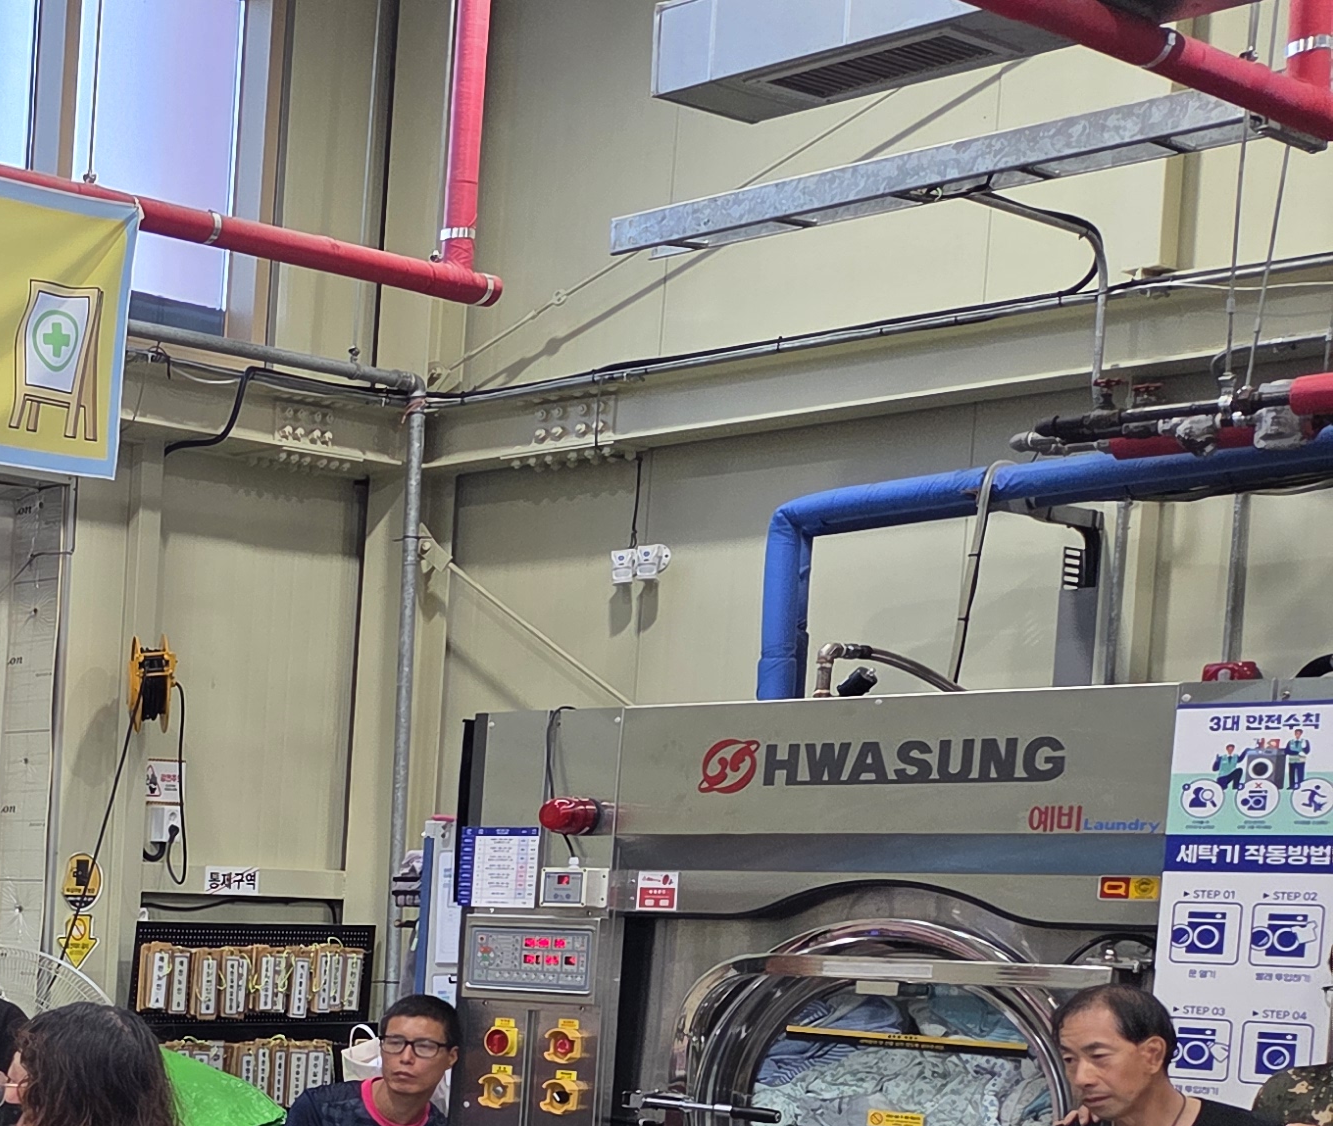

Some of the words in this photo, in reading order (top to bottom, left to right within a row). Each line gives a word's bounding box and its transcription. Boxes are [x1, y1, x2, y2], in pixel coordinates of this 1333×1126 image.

[1209, 715, 1240, 731] 3대
[1246, 713, 1321, 730] 안전수칙
[762, 736, 1066, 786] HWASUNG
[1028, 805, 1083, 832] 예비
[1083, 817, 1161, 834] Laundry
[1176, 844, 1240, 864] 세탁기
[1244, 845, 1331, 865] 작동방법
[208, 871, 257, 890] 통제구역
[1193, 891, 1220, 899] STEP
[1223, 891, 1236, 899] 01
[1273, 892, 1301, 900] STEP
[1303, 892, 1318, 901] 02
[1183, 1006, 1210, 1015] STEP
[1212, 1007, 1226, 1016] 03
[1262, 1010, 1290, 1019] STEP
[1292, 1012, 1307, 1020] 04
